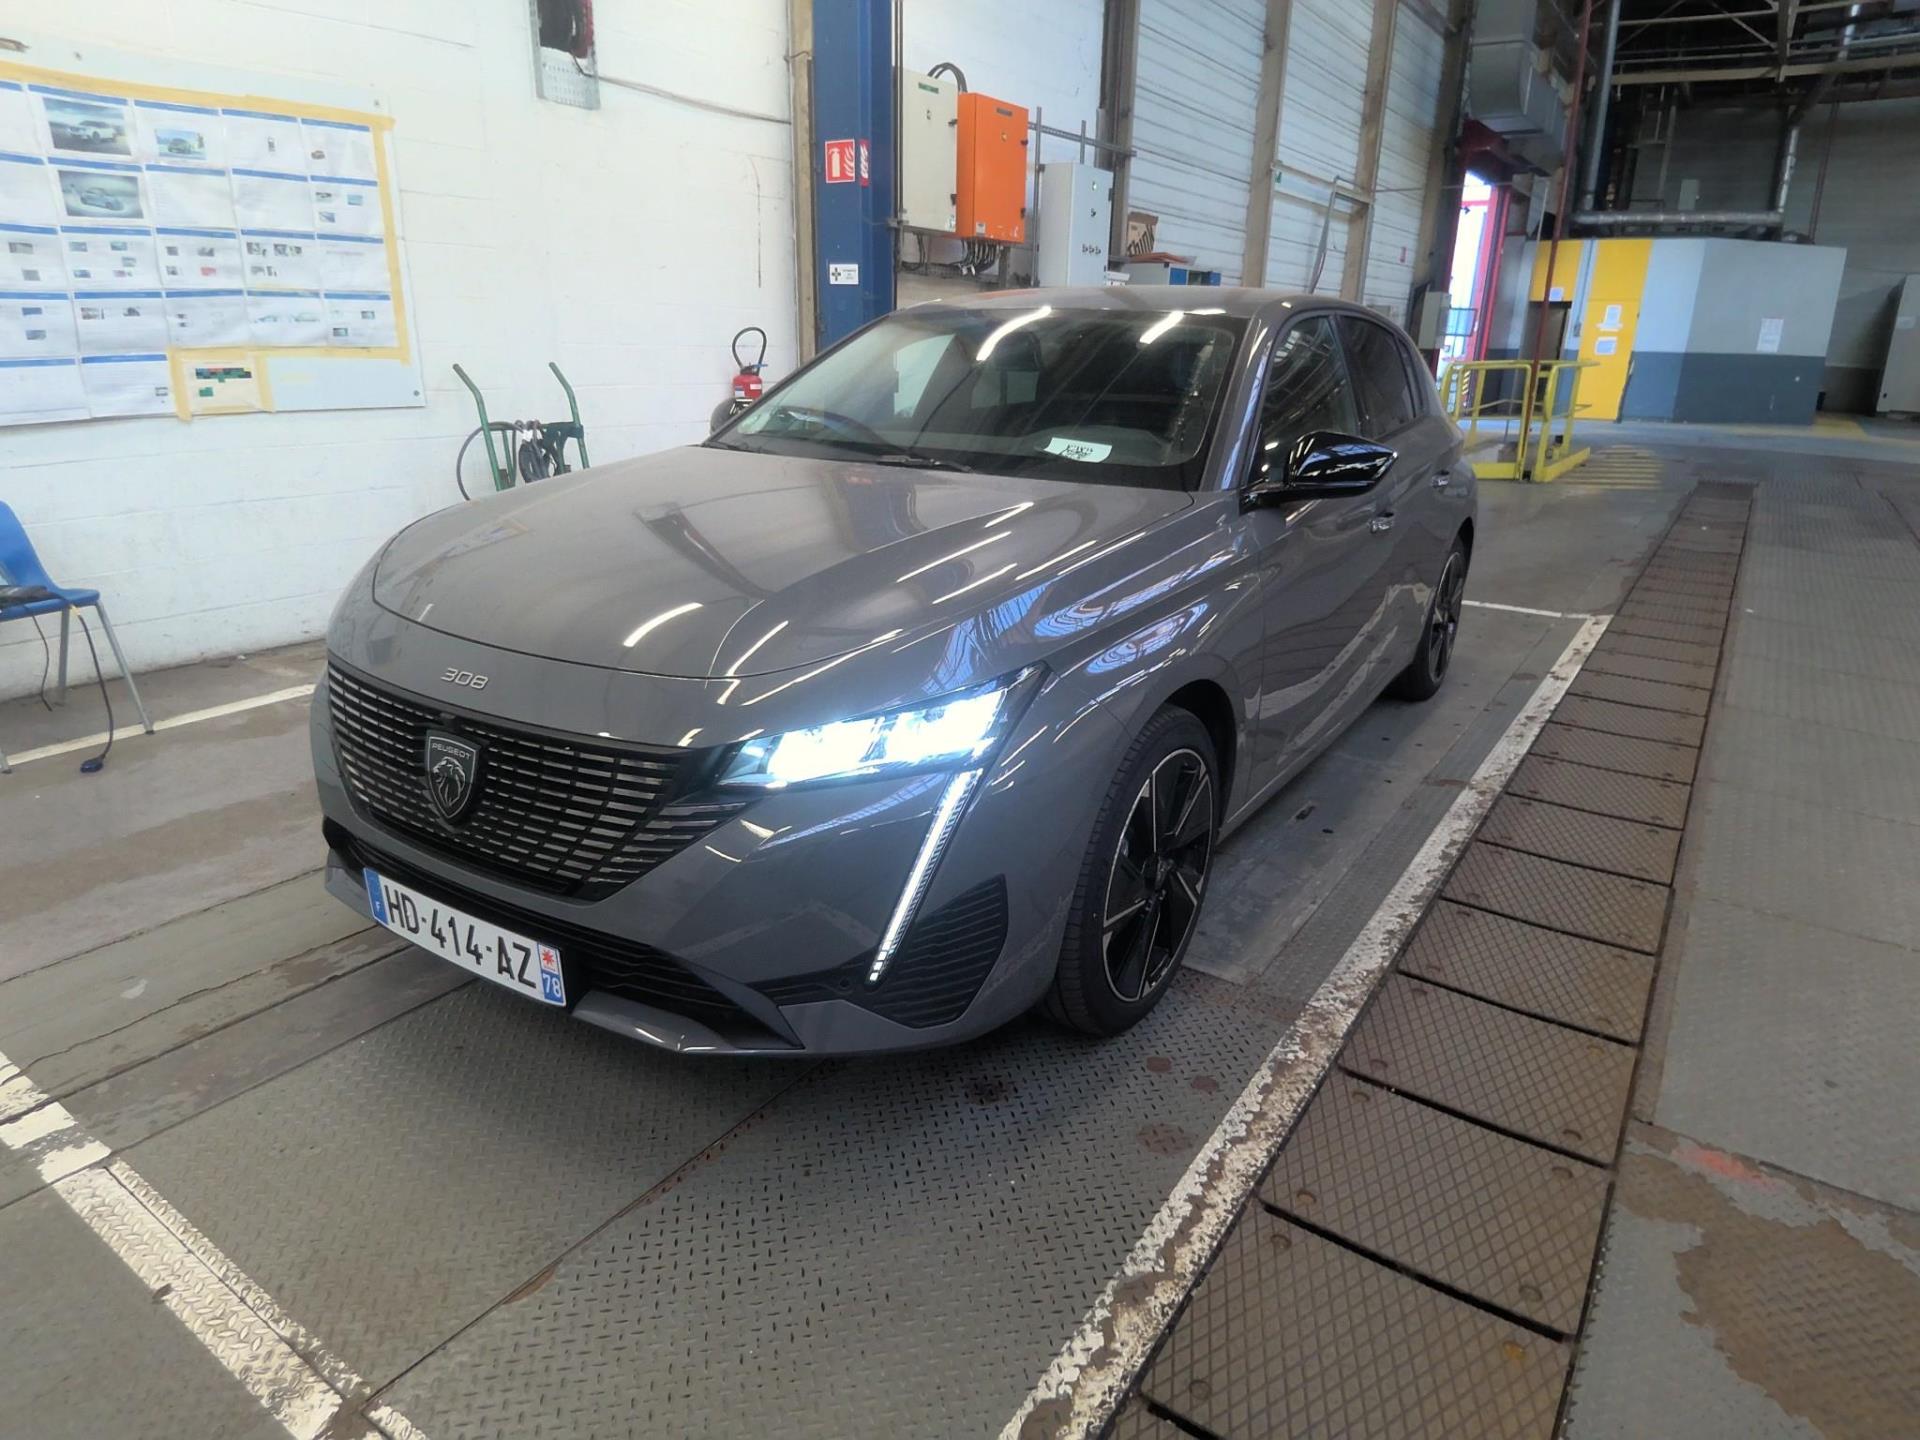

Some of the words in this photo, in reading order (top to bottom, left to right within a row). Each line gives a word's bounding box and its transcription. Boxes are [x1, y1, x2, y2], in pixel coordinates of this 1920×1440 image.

[440, 667, 489, 689] 308
[432, 743, 471, 760] PEUGEOT
[384, 885, 537, 989] HD-414-AZ
[542, 973, 561, 998] 78
